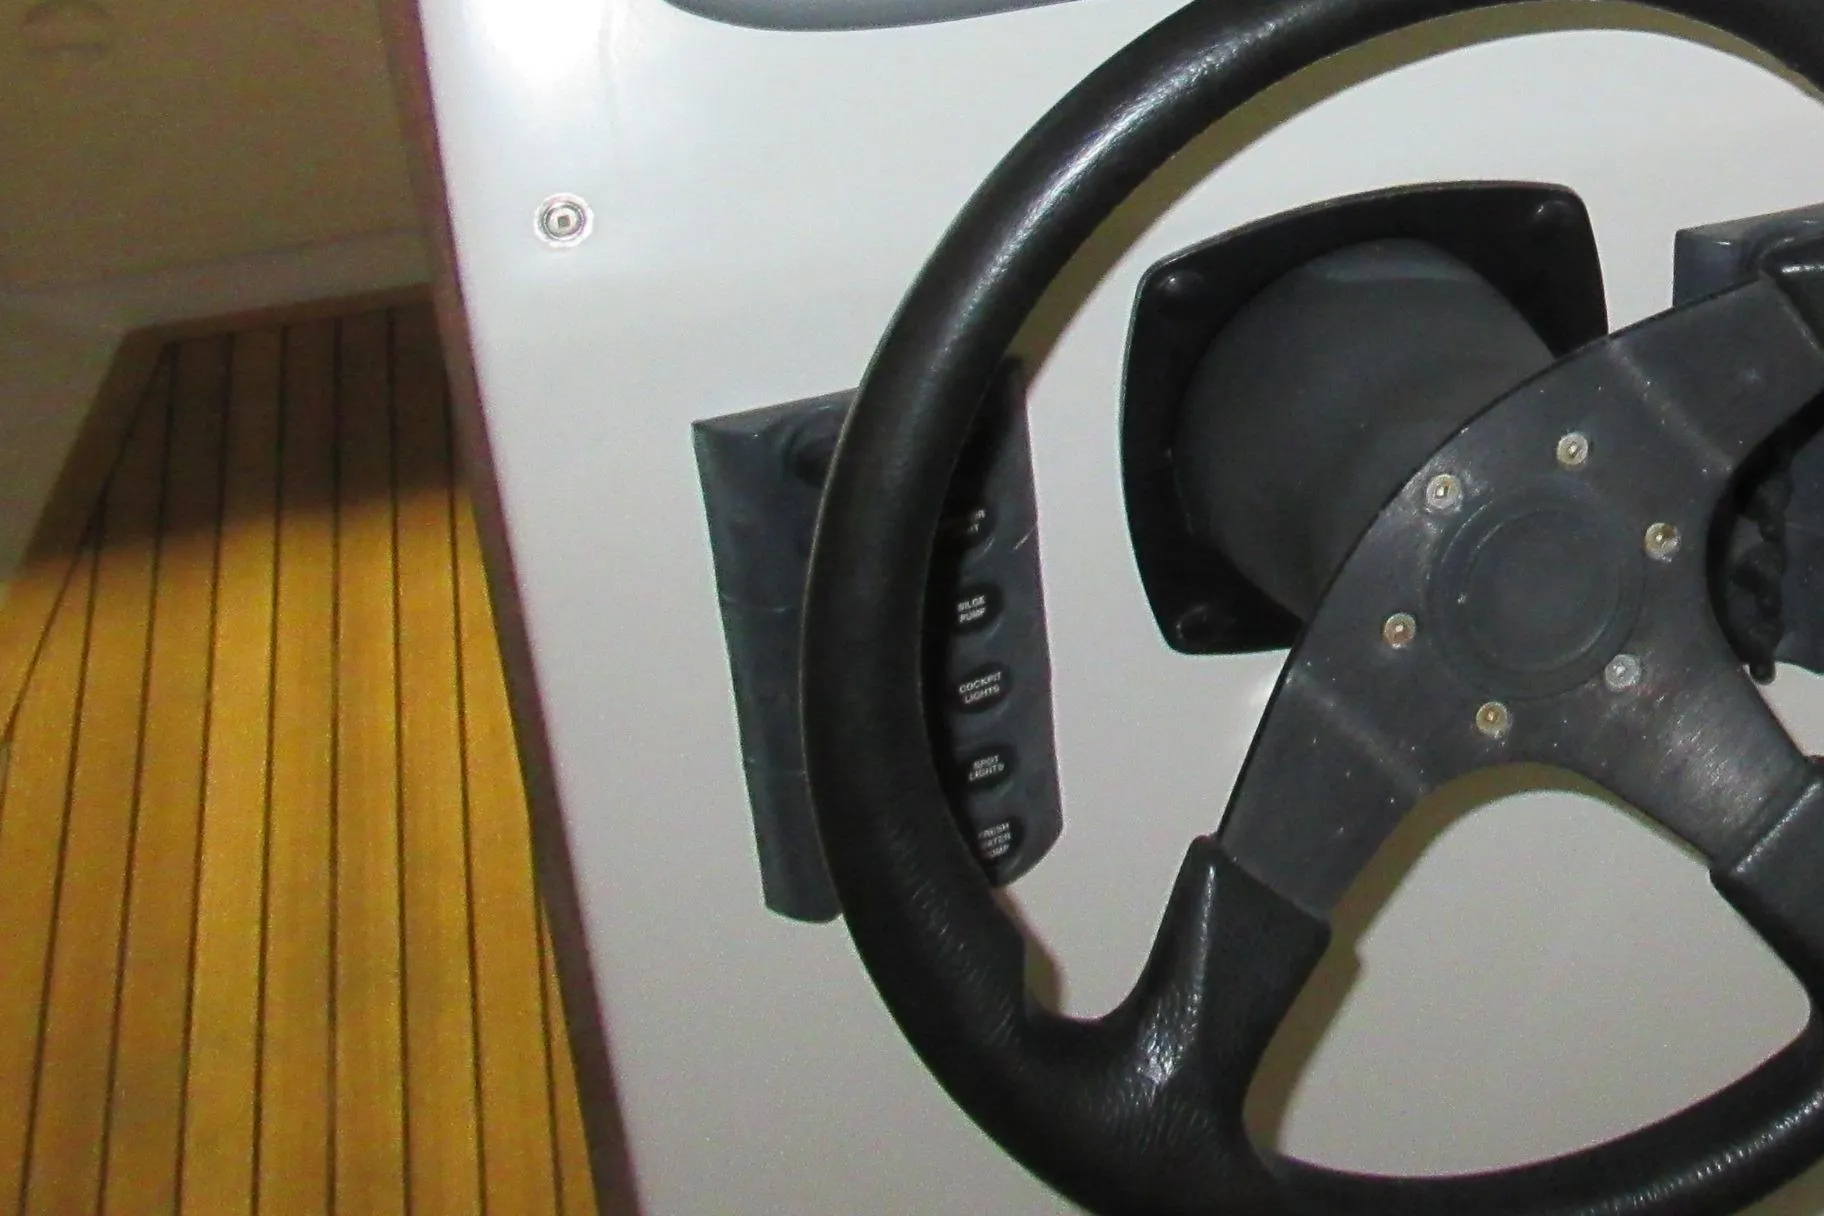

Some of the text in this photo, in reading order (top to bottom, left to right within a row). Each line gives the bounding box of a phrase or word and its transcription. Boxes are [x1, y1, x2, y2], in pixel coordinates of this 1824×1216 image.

[958, 670, 1003, 695] COCKPIT
[963, 683, 1001, 705] LIGHTS
[968, 762, 1005, 783] LIGHTS
